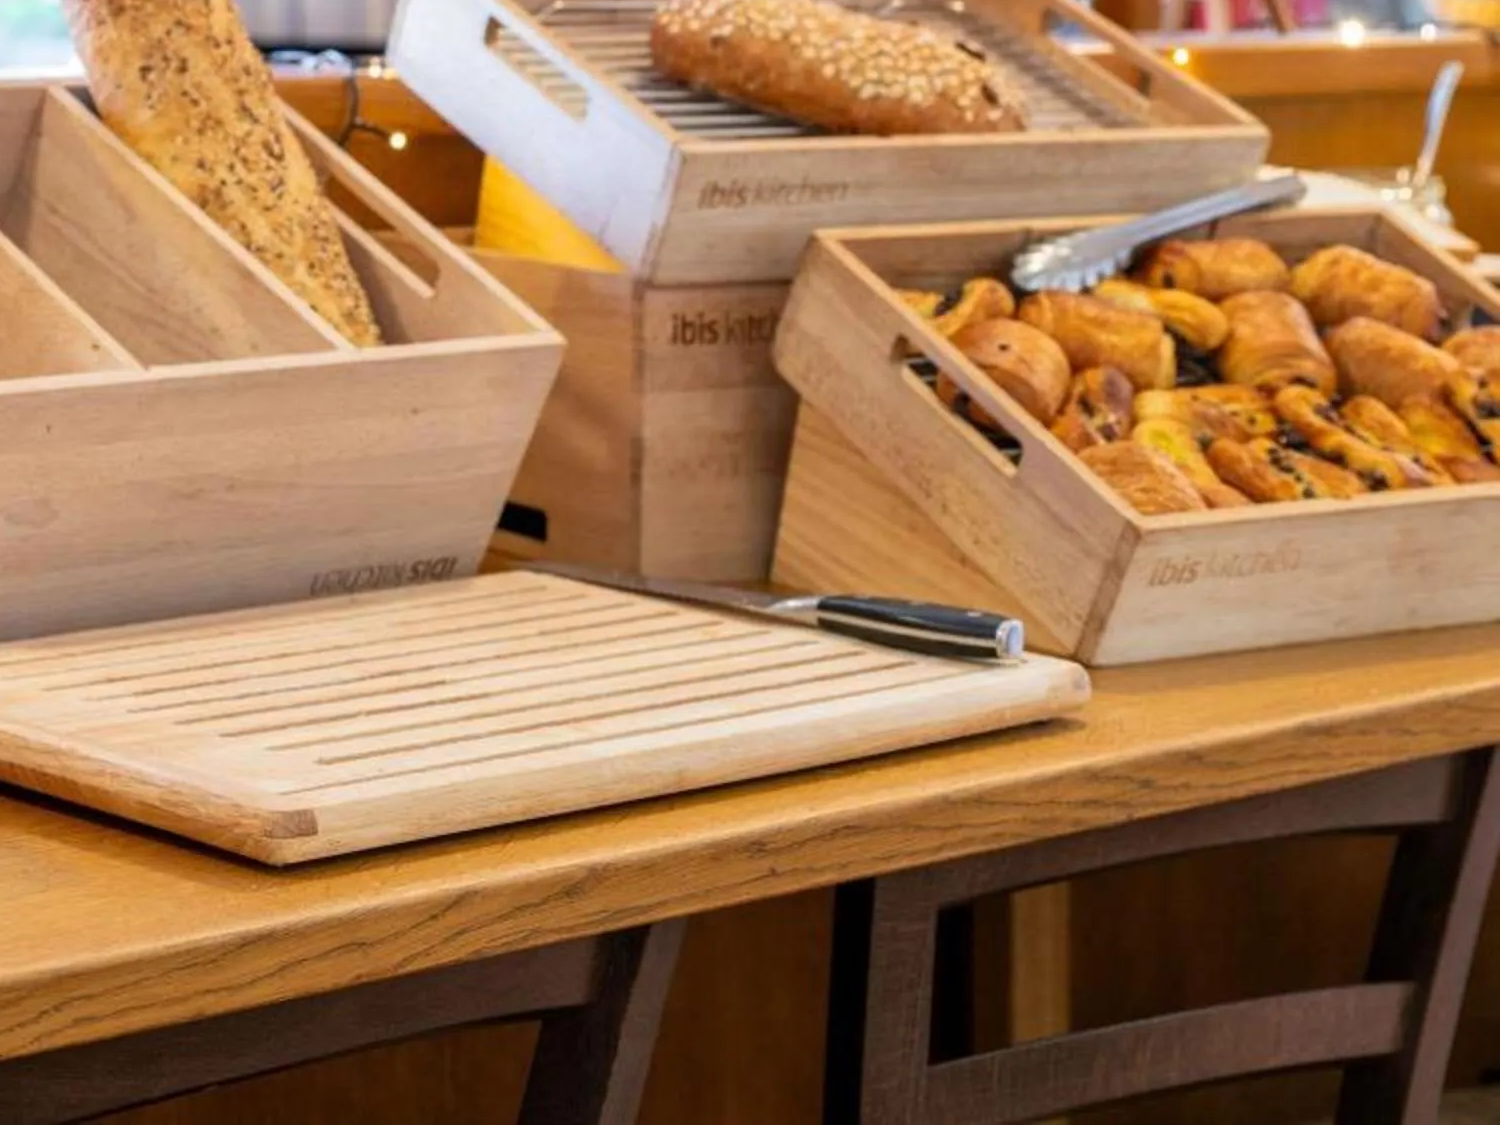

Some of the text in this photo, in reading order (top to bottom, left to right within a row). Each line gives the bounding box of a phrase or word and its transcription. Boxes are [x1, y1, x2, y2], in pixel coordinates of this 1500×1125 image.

[697, 177, 748, 210] ibis
[671, 310, 720, 346] ibis
[1148, 555, 1202, 587] ibis
